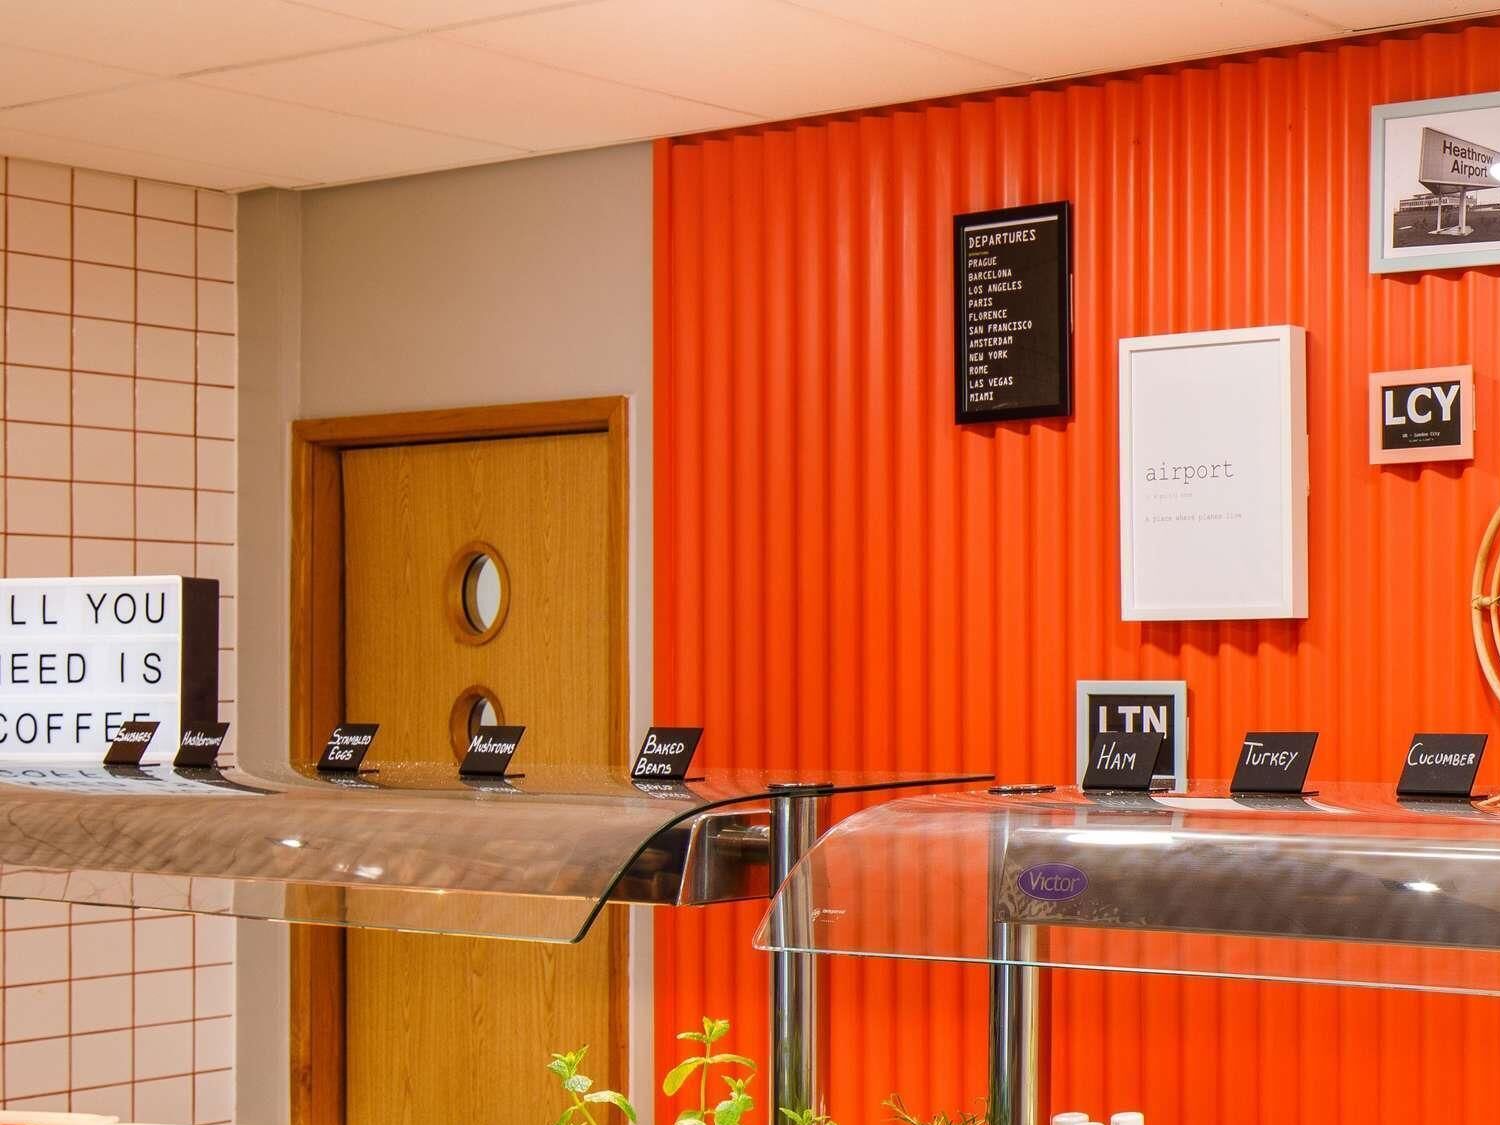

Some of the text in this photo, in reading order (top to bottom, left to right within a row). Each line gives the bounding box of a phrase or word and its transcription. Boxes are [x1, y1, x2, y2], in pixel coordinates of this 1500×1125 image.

[1443, 140, 1493, 164] Heathrow
[1451, 160, 1488, 178] Airport
[968, 229, 1036, 249] DEPARTURES
[968, 256, 997, 268] PRAGUE
[968, 269, 1012, 282] BARCELONA
[968, 281, 1022, 295] LOS ANGELES
[968, 298, 993, 308] PARIS
[968, 310, 1008, 321] FLORENCE
[969, 321, 1032, 335] SAN FRANCISCO
[969, 336, 1013, 348] AMSTERDAM
[969, 350, 1008, 362] NEW YORK
[969, 365, 988, 375] ROME
[969, 376, 1013, 389] LAS VEGAS
[969, 391, 994, 402] MIAMI
[1385, 385, 1460, 425] LCY
[1146, 460, 1234, 484] airport
[87, 593, 165, 624] YOU
[0, 653, 162, 684] EED IS
[1099, 706, 1166, 739] LTN
[644, 734, 684, 755] BAKED
[1029, 871, 1080, 892] Victor
